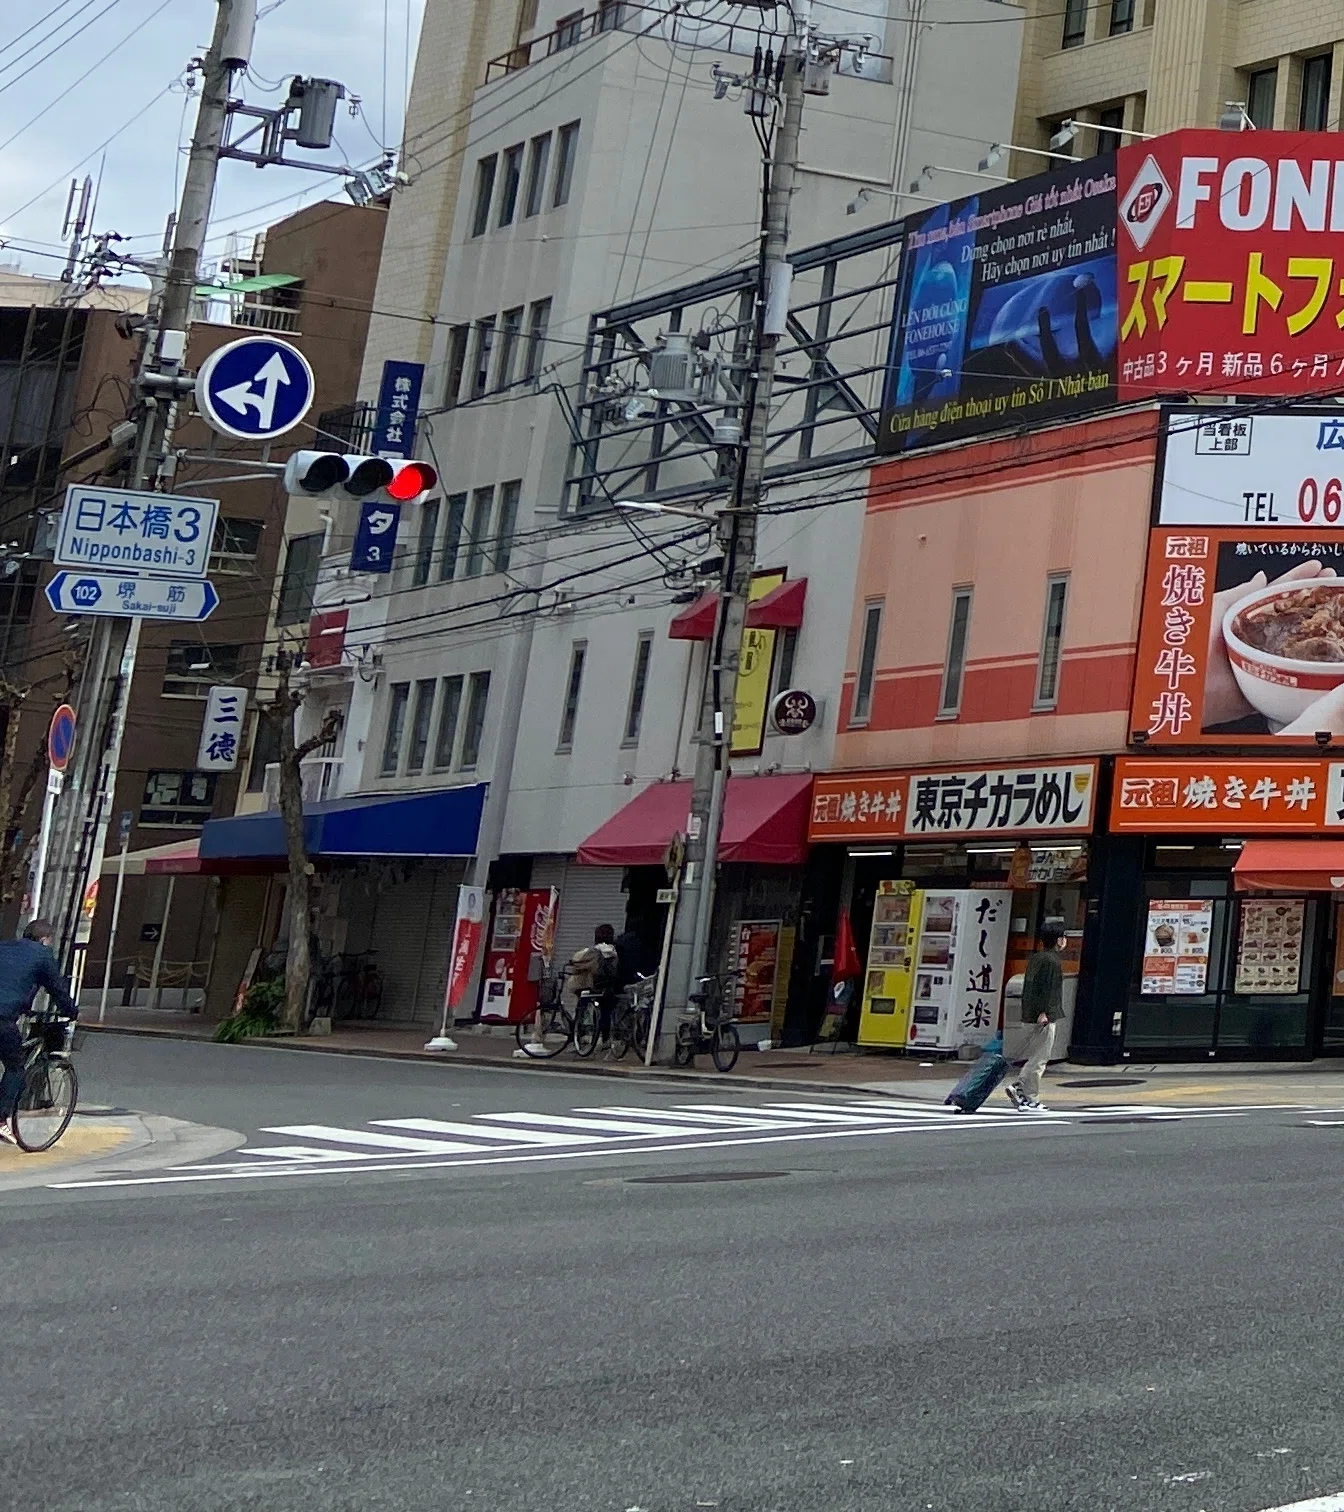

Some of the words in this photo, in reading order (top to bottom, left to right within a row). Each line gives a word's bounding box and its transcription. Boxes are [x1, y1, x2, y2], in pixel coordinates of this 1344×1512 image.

[1202, 423, 1248, 437] 当看板
[1208, 437, 1239, 452] 上部
[75, 498, 201, 542] 日本橋3
[1243, 492, 1279, 523] TEL
[70, 536, 196, 566] Nipponbashi-3
[1167, 537, 1207, 556] 元祖
[75, 585, 98, 601] 102
[121, 599, 177, 615] Sakai-suji
[1147, 563, 1206, 736] 焼き牛丼
[205, 695, 239, 763] 三徳
[912, 770, 1084, 832] 東京チカラめし
[1120, 777, 1178, 808] 元祖
[1182, 775, 1317, 811] 焼き牛丼
[961, 897, 1004, 1029] だし道楽
